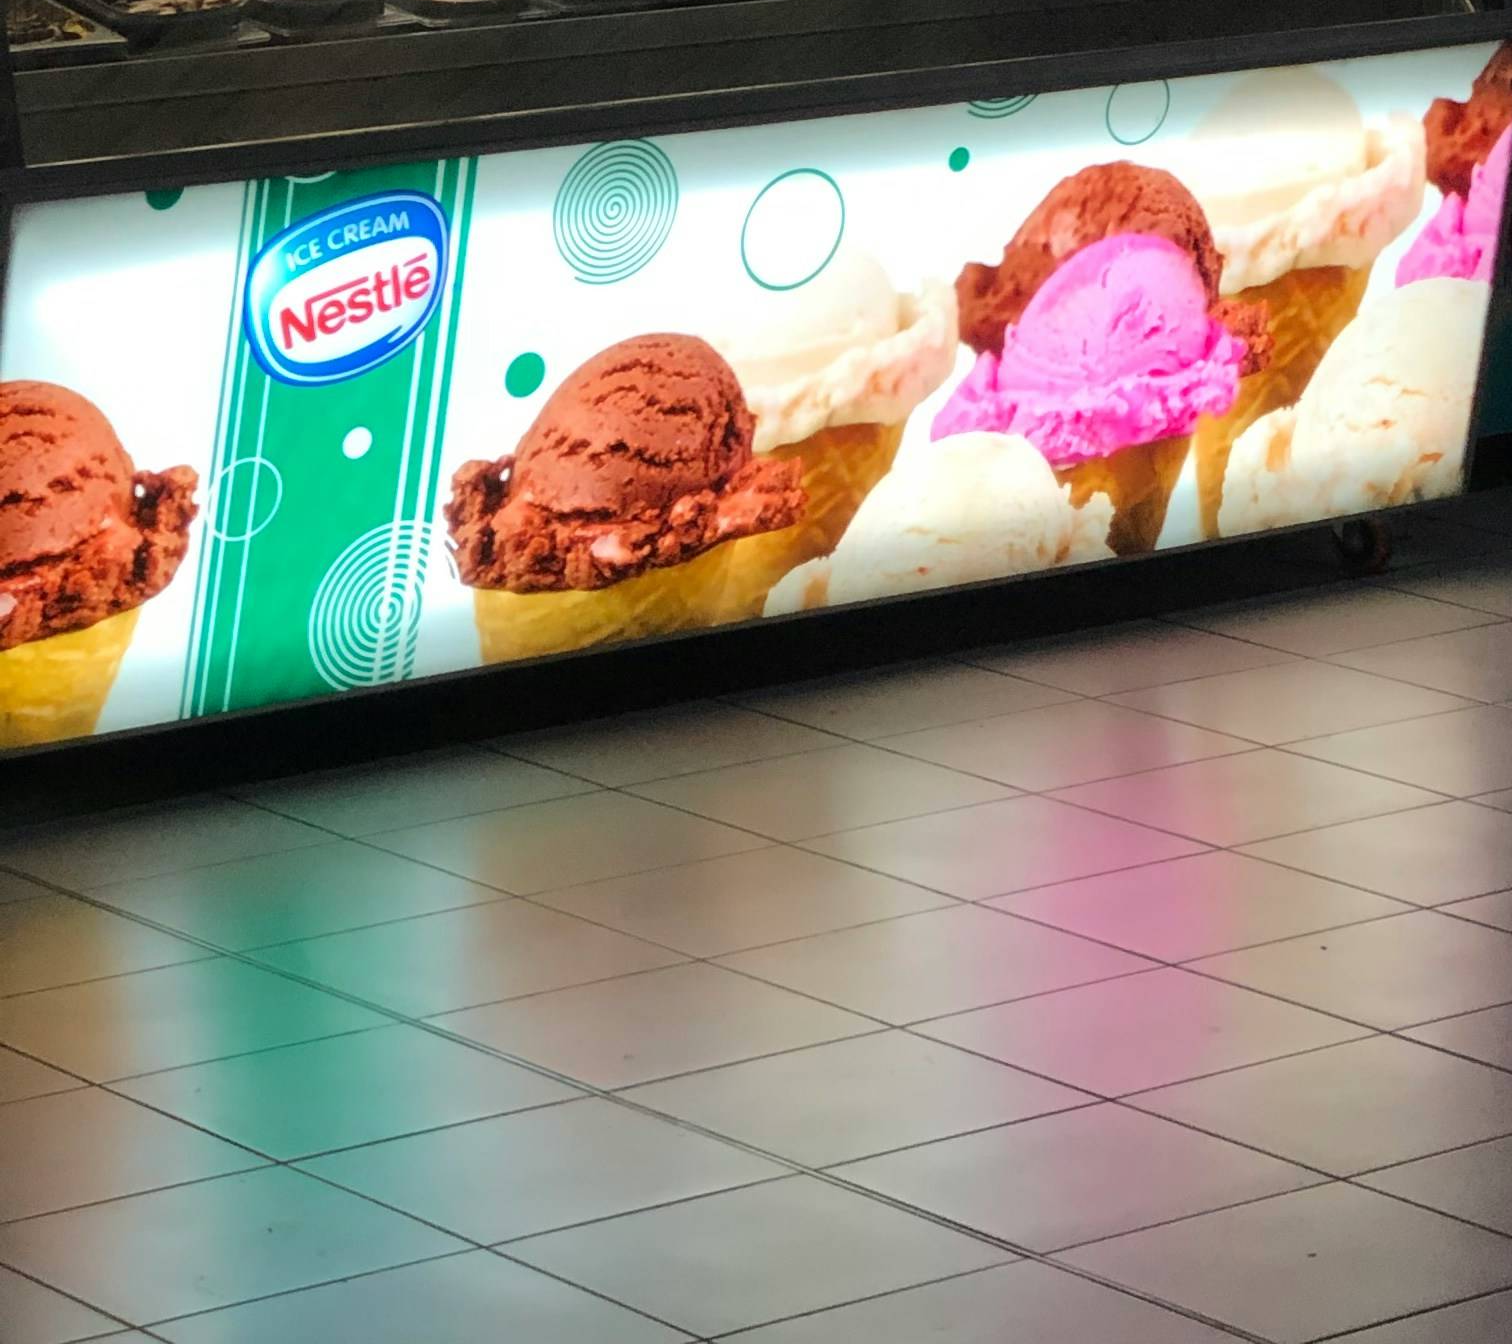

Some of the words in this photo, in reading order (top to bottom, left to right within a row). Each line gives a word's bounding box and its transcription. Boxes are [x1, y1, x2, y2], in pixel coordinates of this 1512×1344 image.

[285, 238, 324, 273] ICE
[326, 210, 411, 252] CREAM
[279, 252, 431, 350] Nestlé
